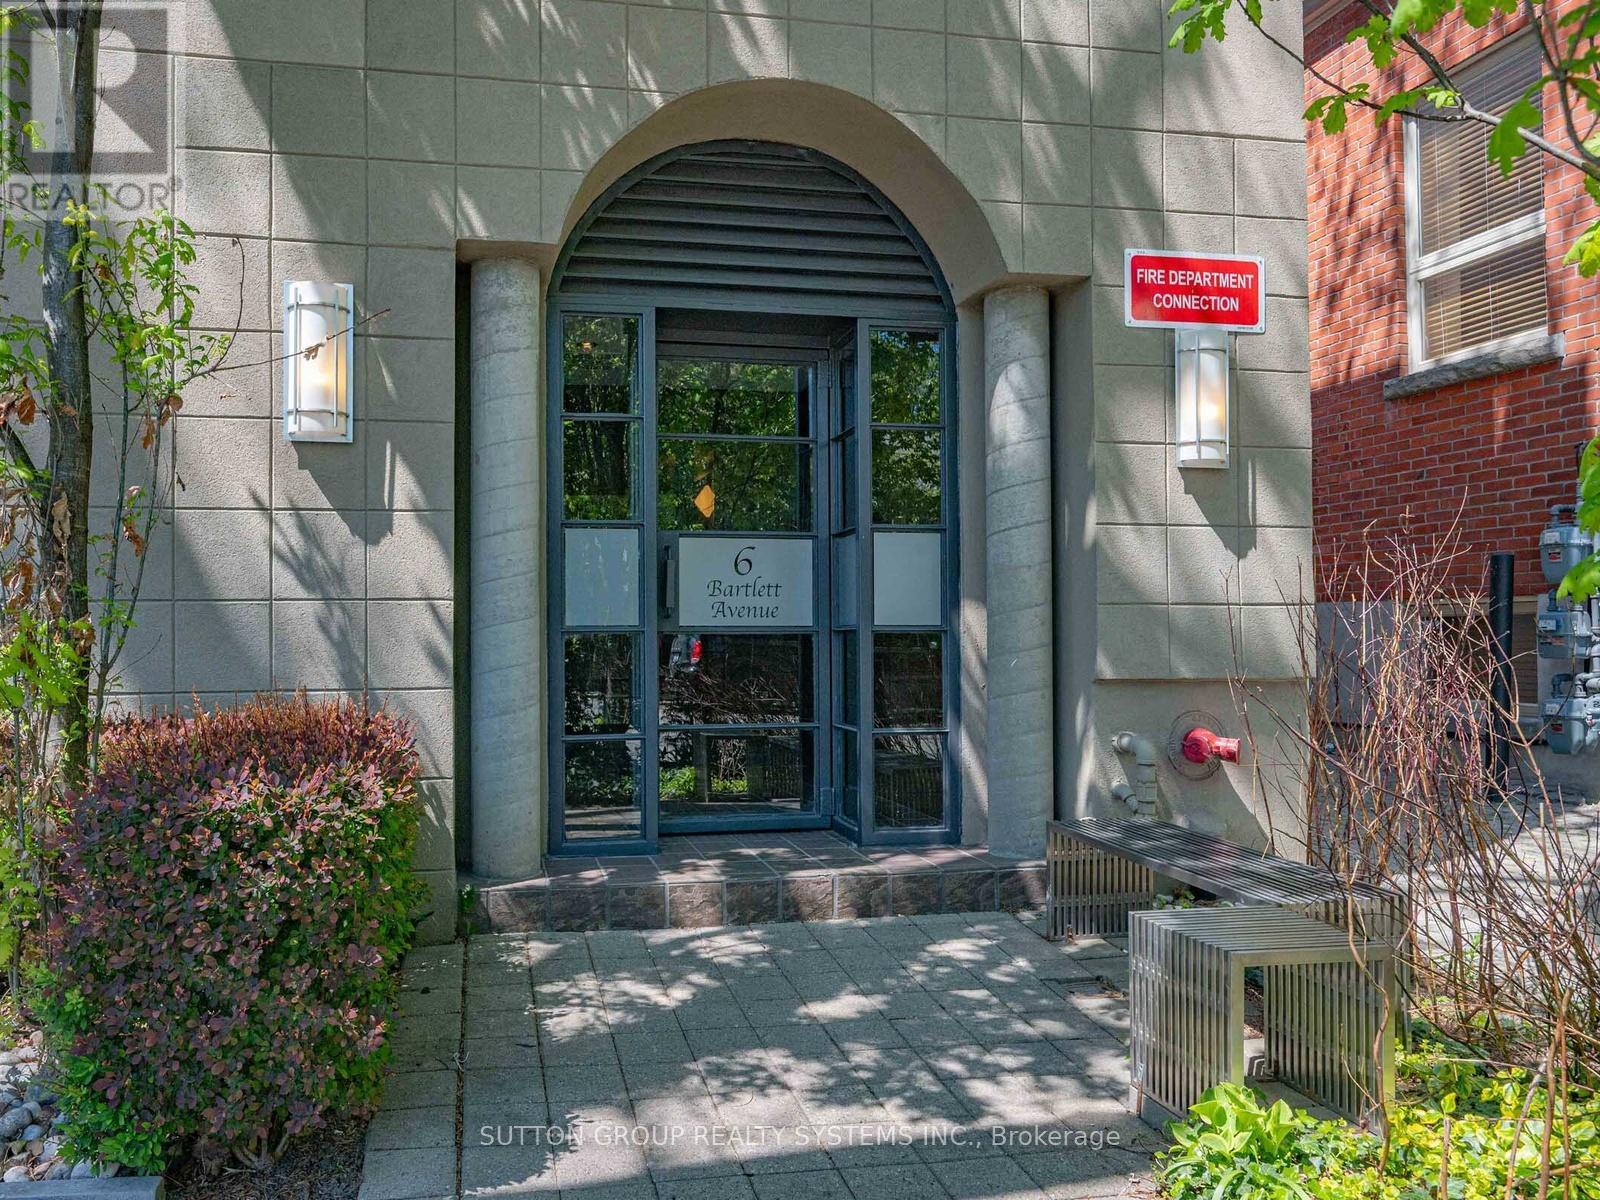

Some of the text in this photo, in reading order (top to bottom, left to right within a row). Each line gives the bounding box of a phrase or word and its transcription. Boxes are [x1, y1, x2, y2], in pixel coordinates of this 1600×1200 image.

[1136, 268, 1254, 289] FIRE DEPARTMENT
[1153, 293, 1239, 311] CONNECTION
[734, 546, 756, 576] 6
[707, 576, 783, 598] Bartlett
[711, 601, 779, 618] Avenue
